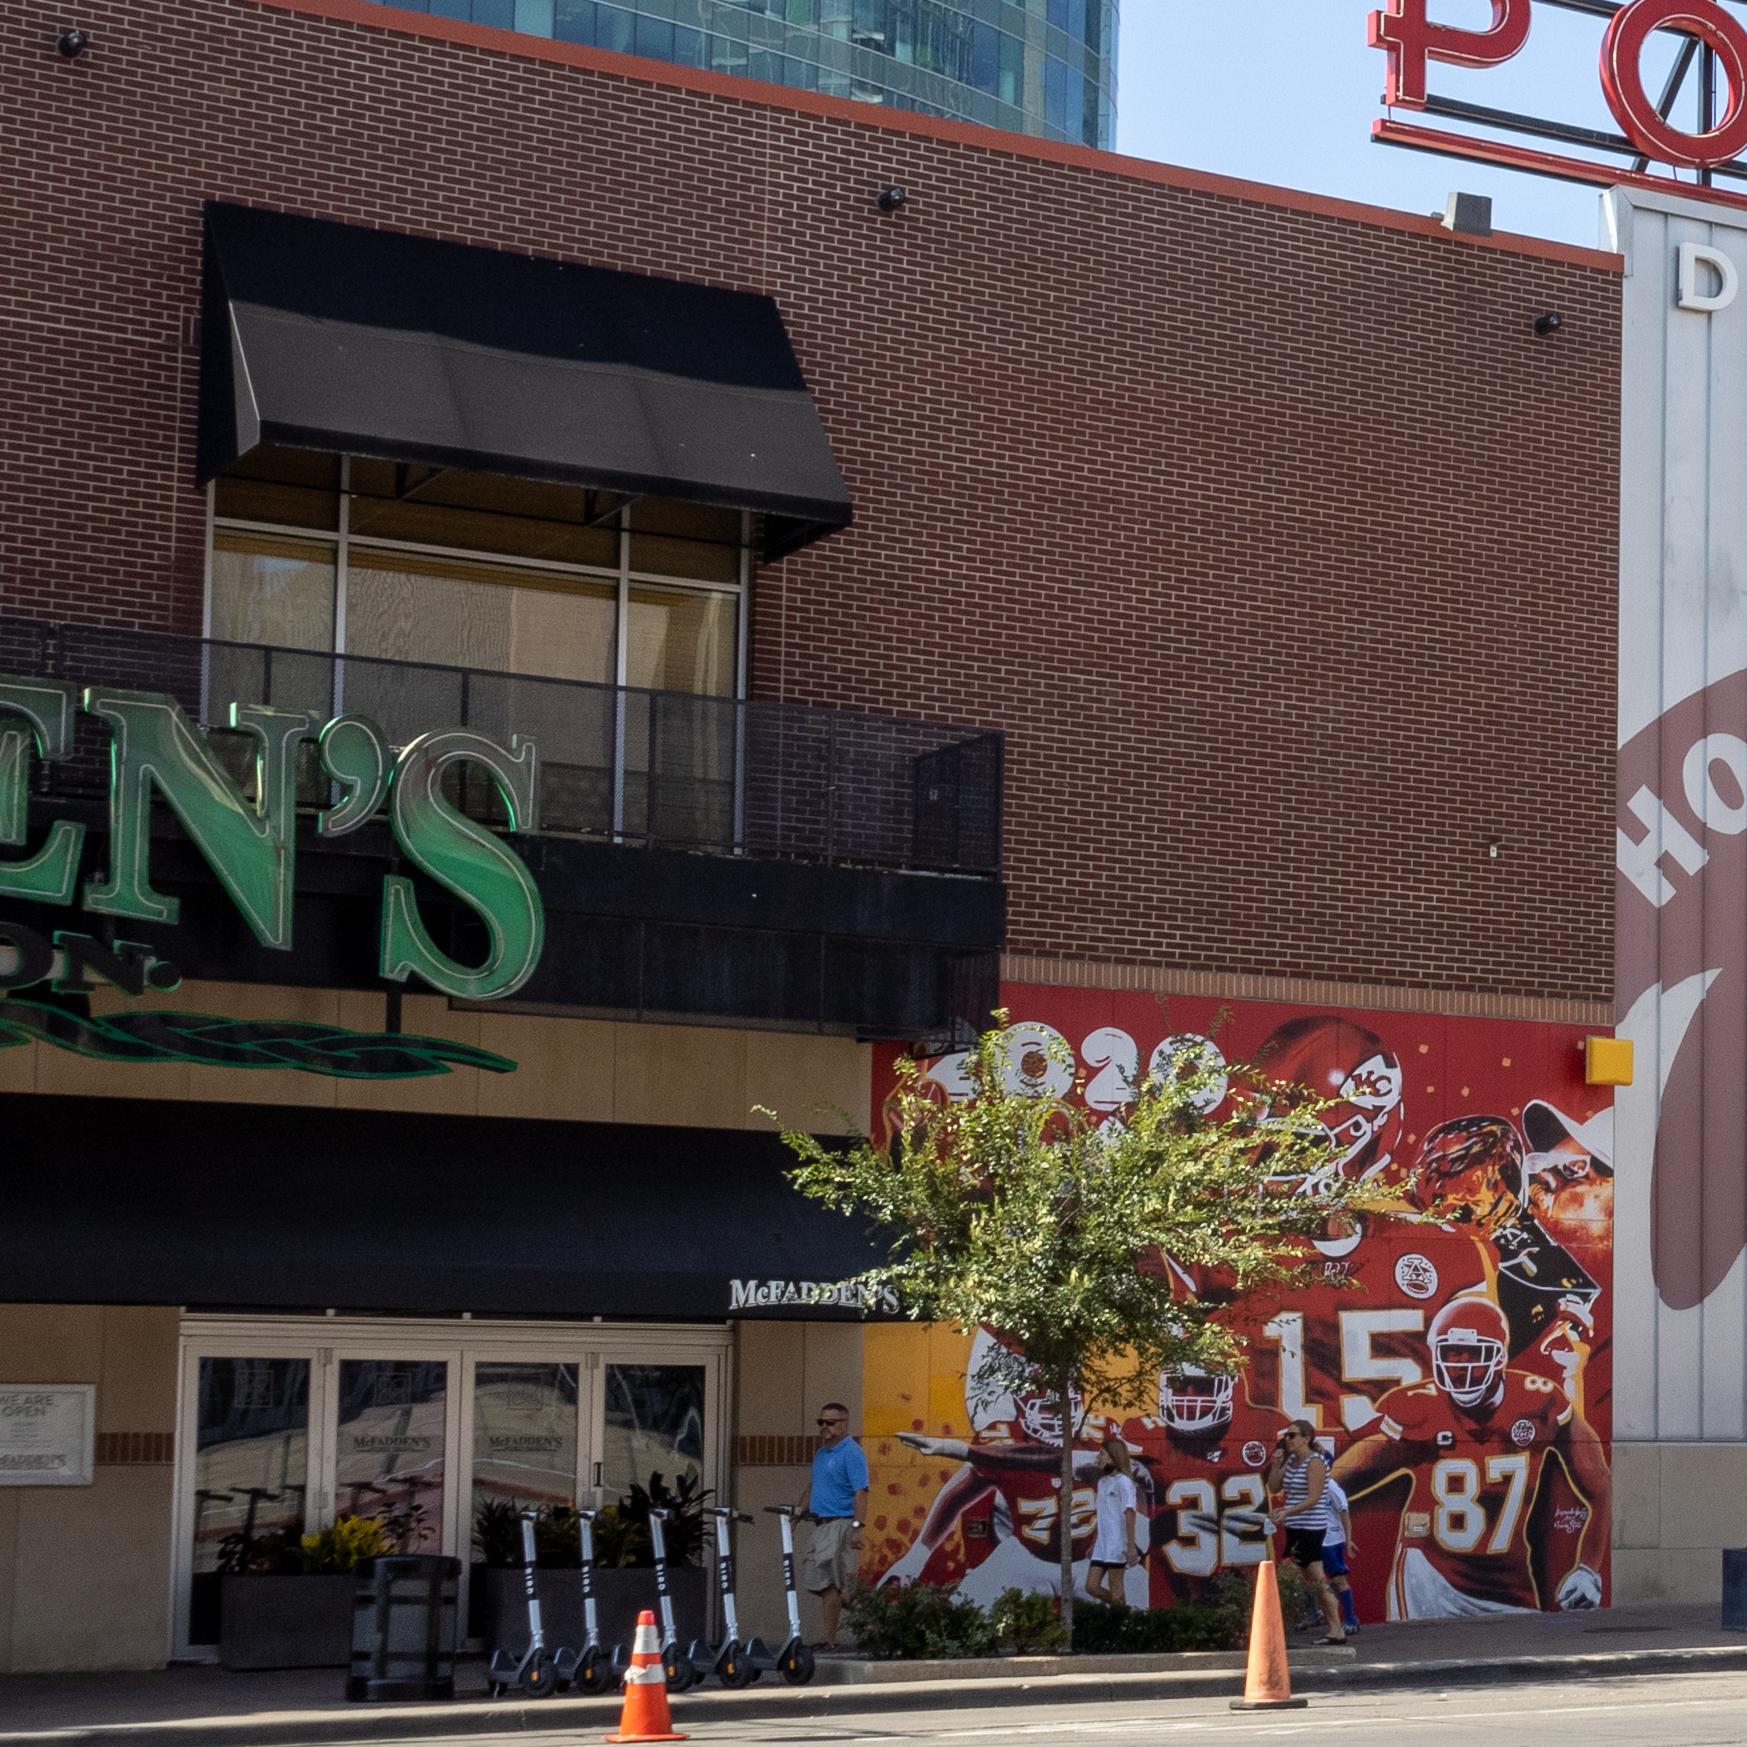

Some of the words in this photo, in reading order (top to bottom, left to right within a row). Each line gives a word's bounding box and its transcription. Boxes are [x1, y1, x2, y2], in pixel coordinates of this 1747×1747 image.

[1263, 1308, 1425, 1432] 15
[1161, 1473, 1270, 1577] 32
[1431, 1451, 1531, 1555] 87
